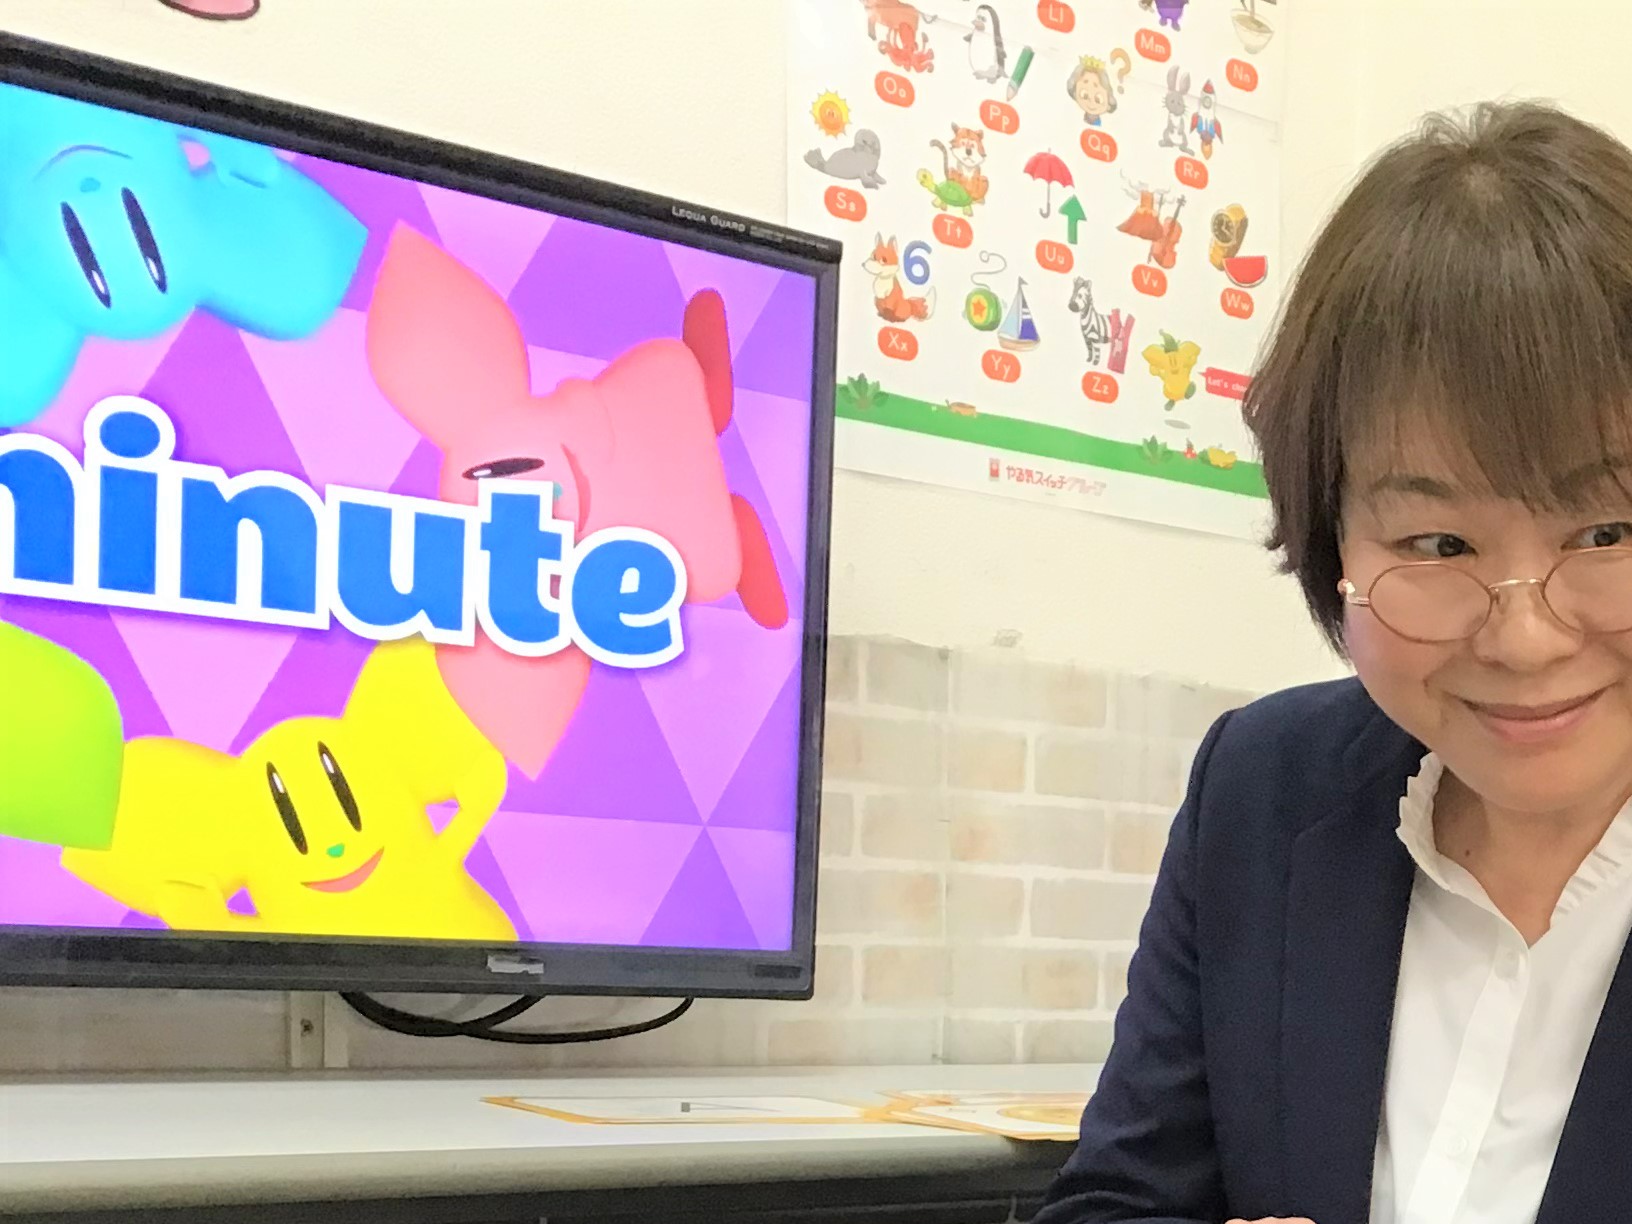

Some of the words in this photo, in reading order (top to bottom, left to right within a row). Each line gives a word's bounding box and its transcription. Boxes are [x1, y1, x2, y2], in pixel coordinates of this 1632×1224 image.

[1140, 34, 1166, 55] Mm
[1233, 65, 1250, 83] Nn
[883, 77, 906, 98] Oo
[989, 104, 1010, 129] Pp
[1087, 134, 1110, 160] Qq
[1183, 160, 1200, 179] Rr
[836, 192, 857, 213] Ss
[710, 214, 746, 233] GUARD
[943, 218, 962, 239] Tt
[903, 239, 932, 285] 6
[1045, 243, 1065, 265] Uu
[1140, 270, 1160, 289] Vv
[1226, 292, 1250, 312] Ww
[888, 331, 908, 352] Xx
[992, 355, 1010, 381] Yy
[1092, 375, 1109, 396] Zz
